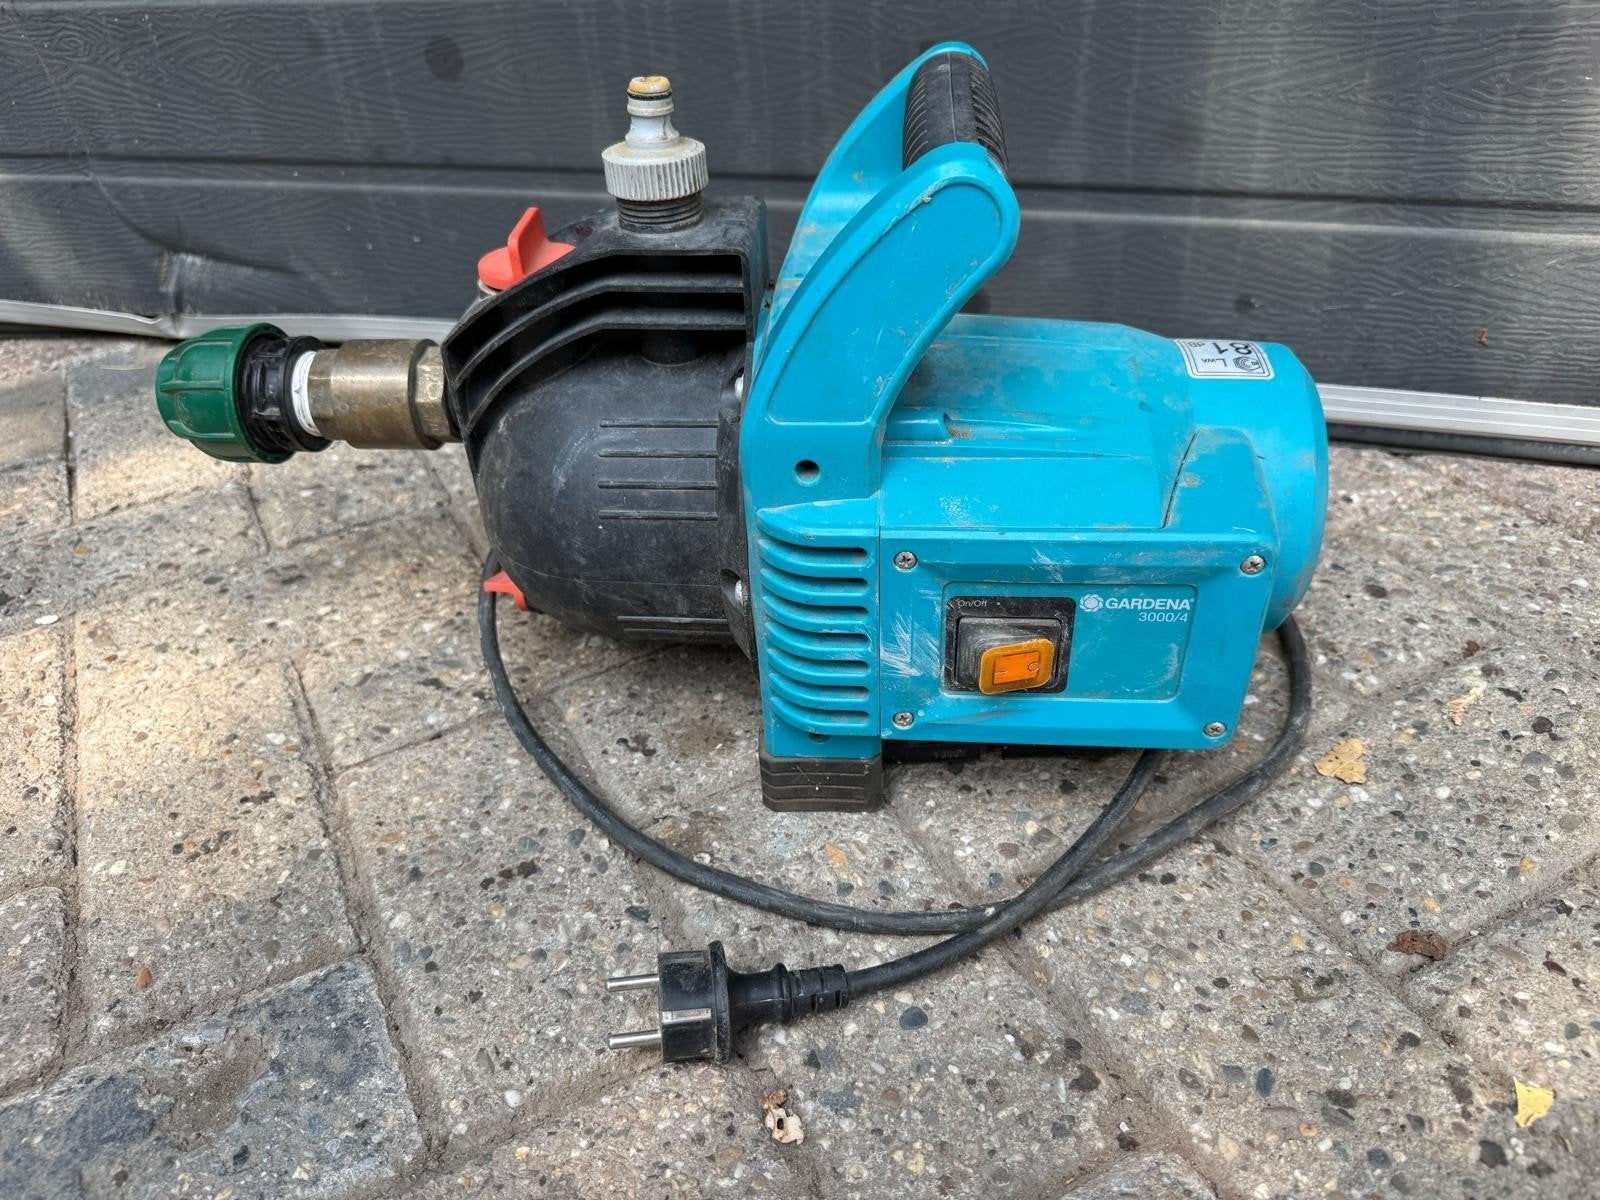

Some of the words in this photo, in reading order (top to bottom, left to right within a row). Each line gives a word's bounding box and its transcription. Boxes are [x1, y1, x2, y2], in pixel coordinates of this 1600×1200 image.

[1212, 342, 1252, 355] 81
[957, 599, 988, 608] On/Off
[1138, 612, 1189, 623] 3000/4
